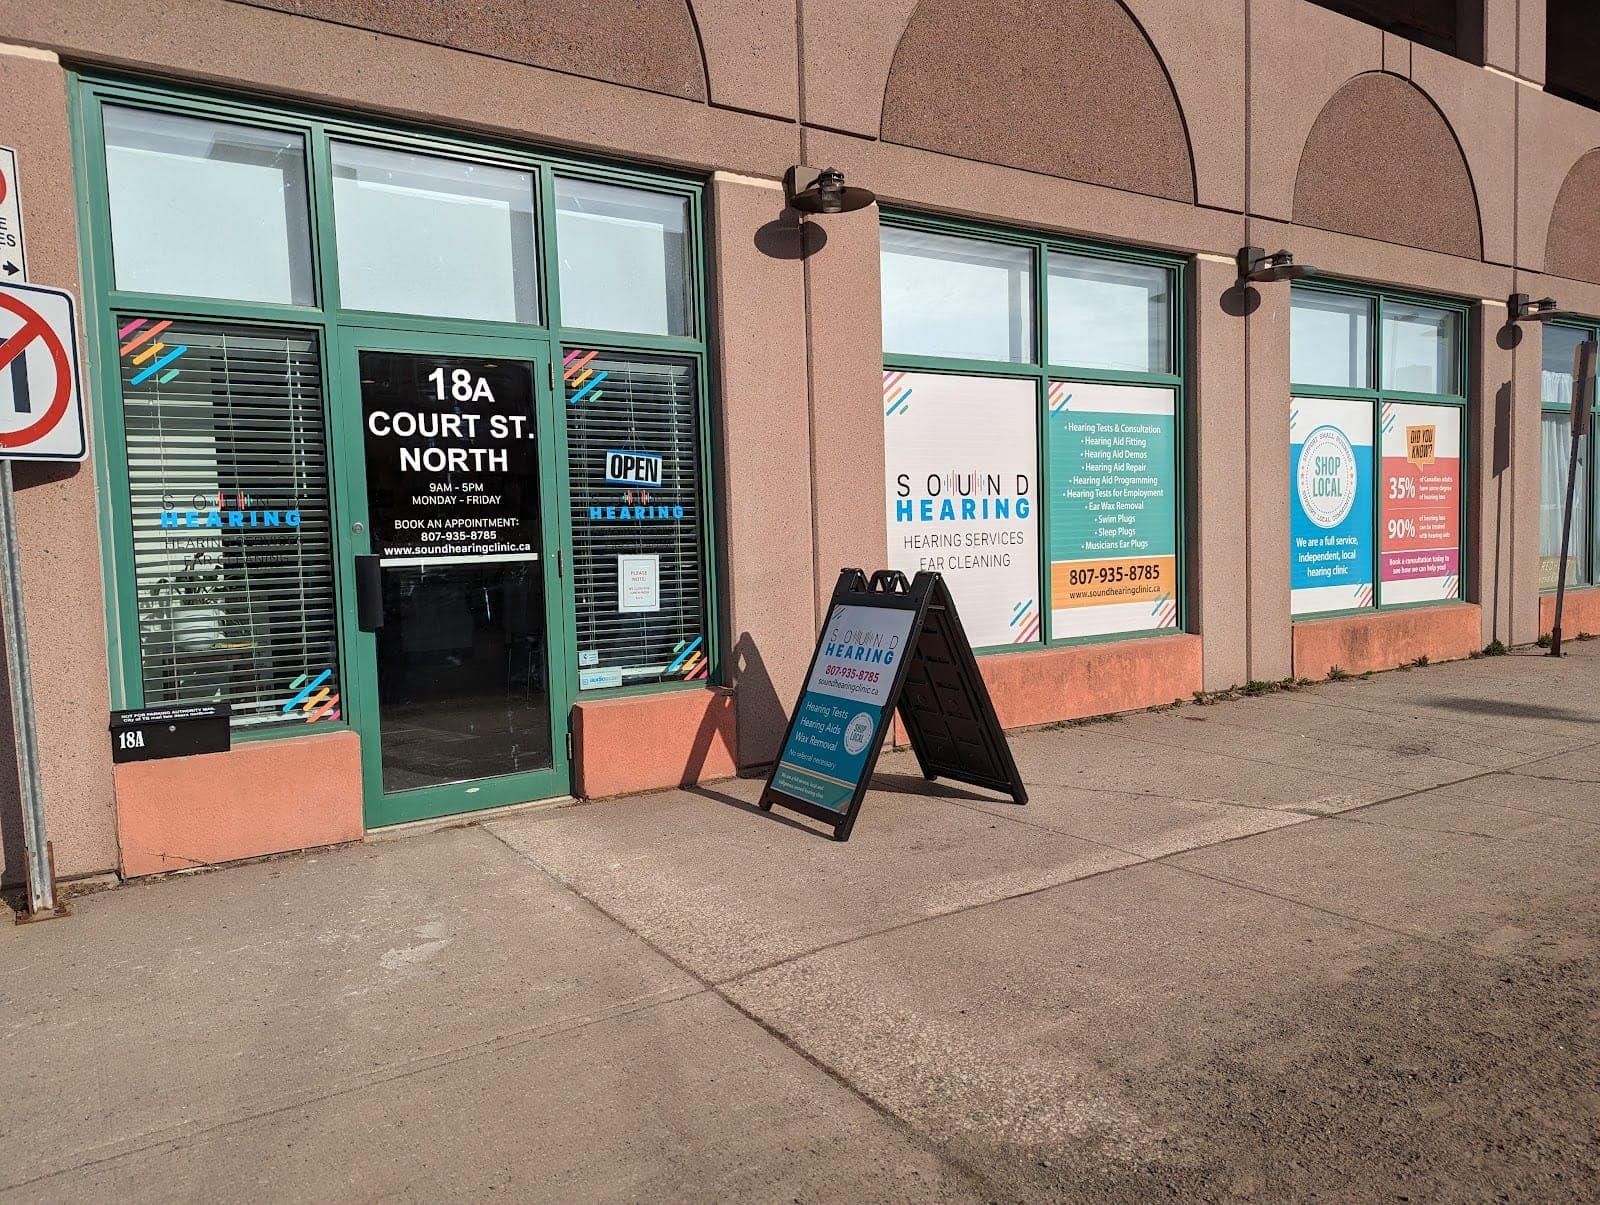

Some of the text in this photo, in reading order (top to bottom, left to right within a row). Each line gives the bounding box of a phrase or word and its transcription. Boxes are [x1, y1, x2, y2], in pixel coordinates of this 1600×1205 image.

[428, 367, 495, 403] 18A
[368, 411, 534, 439] COURT ST.
[1068, 422, 1161, 433] Hearing Tests & Consultation
[1085, 437, 1146, 448] Hearing Aid Fitting
[1411, 429, 1433, 443] DID YOU
[1084, 450, 1147, 460] Hearing Aid Demos
[1412, 444, 1433, 459] KNOW?
[400, 447, 508, 472] NORTH
[1314, 456, 1341, 475] SHOP
[610, 454, 658, 482] OPEN
[1085, 463, 1146, 473] Hearing Aid Repair
[429, 483, 453, 492] 9AM
[461, 483, 484, 492] 5PM
[896, 473, 1029, 497] SOUND
[1073, 476, 1158, 486] Hearing Aid Programming
[1313, 478, 1342, 497] LOCAL
[1389, 476, 1416, 499] 35%
[412, 496, 457, 505] MONDAY
[466, 495, 501, 505] FRIDAY
[1067, 488, 1164, 499] Hearing Tests for Employment
[589, 505, 684, 520] HEARING
[896, 498, 1030, 522] HEARING
[1089, 501, 1144, 510] Ear Wax Removal
[160, 511, 302, 529] HEARING
[394, 518, 520, 529] BOOK AN APPOINTMENT:
[1098, 514, 1136, 523] Swim Plugs
[1098, 527, 1136, 537] Sleep Plugs
[1388, 518, 1416, 539] 90%
[420, 531, 497, 542] 807-935-8785
[904, 532, 1024, 549] HEARING SERVICES
[1296, 537, 1307, 547] We
[1324, 536, 1335, 545] full
[1336, 536, 1359, 546] service,
[384, 542, 531, 556] www.soundhearingclinic.ca
[1085, 540, 1149, 550] Musicians Ear Plugs
[920, 553, 1011, 570] EAR CLEANING
[1298, 549, 1356, 564] independent, local
[1069, 565, 1160, 585] 807-935-8785
[1307, 565, 1348, 577] hearing clinic
[1069, 585, 1160, 599] www.soundhearingclinic.ca
[831, 628, 899, 650] SOUND
[825, 642, 894, 665] HEARING
[825, 664, 880, 683] 807-935-8785
[818, 678, 879, 696] soundhearingclinic.ca
[806, 701, 849, 720] Hearing Tests
[800, 716, 841, 735] Hearing Aids
[119, 731, 145, 749] 18A
[795, 731, 838, 752] Wax Removal
[789, 748, 797, 756] No
